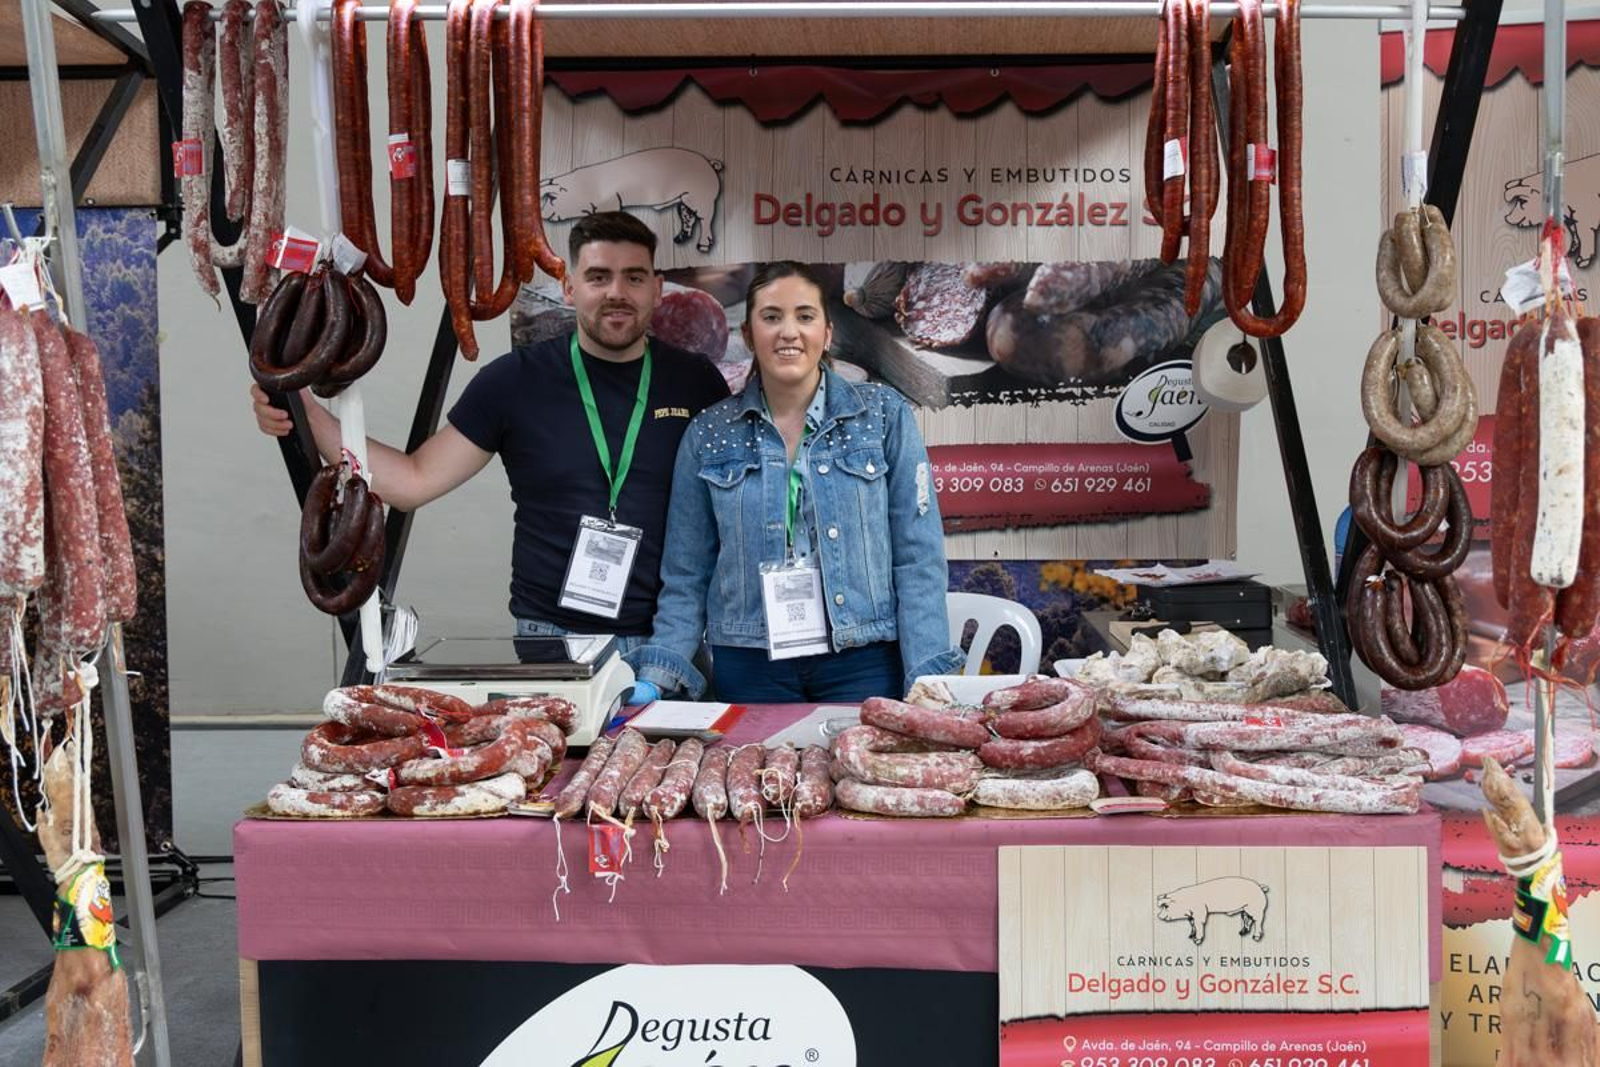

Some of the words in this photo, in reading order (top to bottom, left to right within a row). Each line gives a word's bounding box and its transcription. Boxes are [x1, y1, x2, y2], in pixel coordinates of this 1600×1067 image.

[829, 166, 949, 184] CÁRNICAS
[963, 168, 976, 183] Y
[991, 168, 1132, 183] EMBUTIDOS
[753, 192, 907, 236] Delgado
[920, 202, 943, 236] y
[956, 192, 1129, 227] González
[945, 462, 957, 472] de
[990, 463, 1003, 472] 94
[1013, 462, 1060, 474] Campillo
[1063, 462, 1075, 472] de
[1078, 462, 1113, 473] Arenas
[1116, 463, 1150, 474] (Jaén)
[949, 477, 984, 493] 309
[989, 477, 1024, 493] 083
[1051, 477, 1079, 493] 651
[1084, 477, 1117, 493] 929
[1123, 477, 1151, 493] 461
[1117, 954, 1193, 968] CÁRNICAS
[1203, 957, 1211, 967] Y
[1220, 957, 1310, 968] EMBUTIDOS
[1068, 973, 1166, 999] Delgado
[1176, 979, 1190, 999] y
[1199, 973, 1308, 995] González
[1319, 974, 1360, 995] S.C.
[588, 1000, 772, 1055] Degusta
[1081, 1039, 1118, 1051] Avda.
[1120, 1039, 1135, 1051] de
[1175, 1040, 1191, 1051] 94
[1203, 1040, 1258, 1052] Campillo
[1261, 1040, 1276, 1051] de
[1280, 1040, 1323, 1051] Arenas
[1326, 1040, 1367, 1053] (Jaén)
